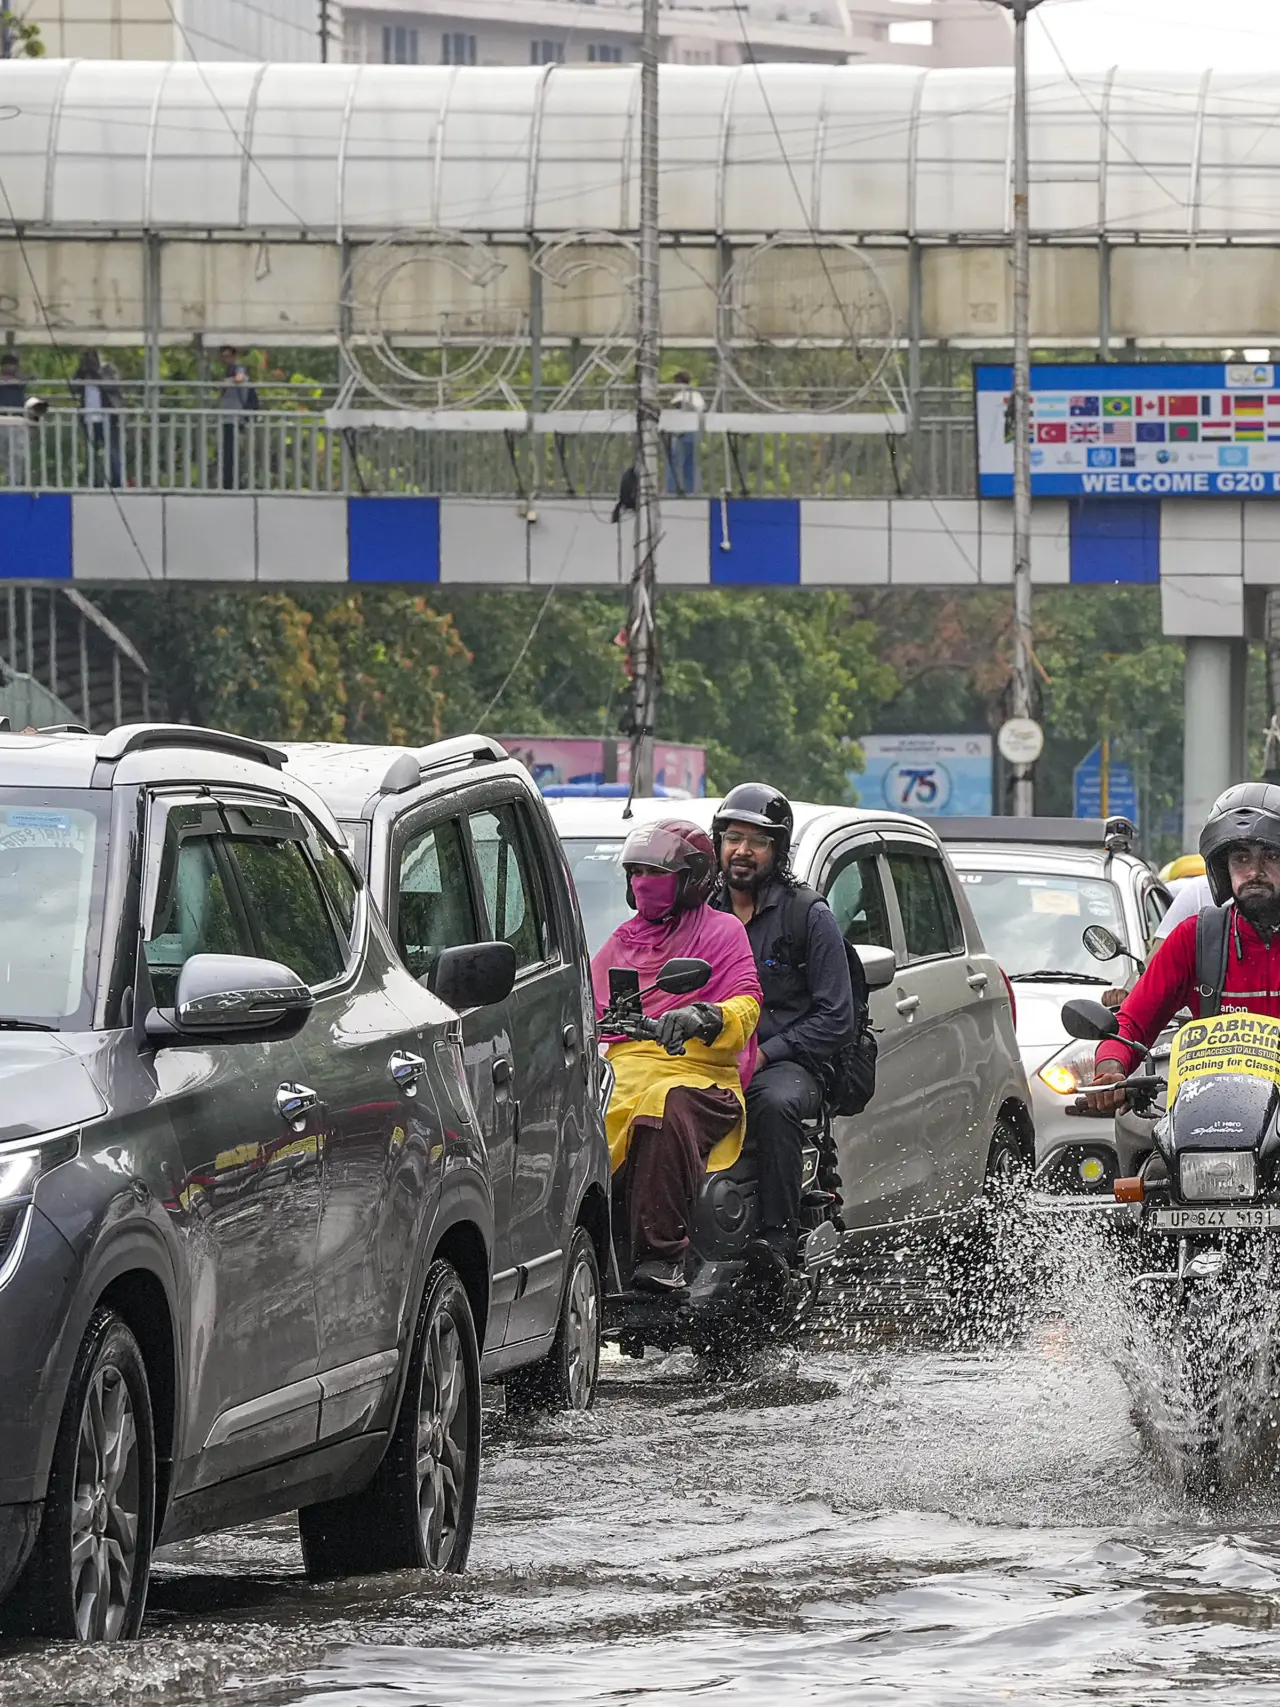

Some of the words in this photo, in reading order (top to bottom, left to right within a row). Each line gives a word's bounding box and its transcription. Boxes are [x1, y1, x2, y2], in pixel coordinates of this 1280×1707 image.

[1082, 473, 1209, 492] WELCOME
[1216, 473, 1265, 492] G20
[898, 768, 938, 804] 75
[1220, 1003, 1249, 1014] arbon
[1206, 1047, 1233, 1057] ACCESS
[1243, 1047, 1257, 1056] ALL
[1178, 1059, 1224, 1077] Coaching
[1227, 1057, 1244, 1067] for
[1171, 1212, 1190, 1227] UP
